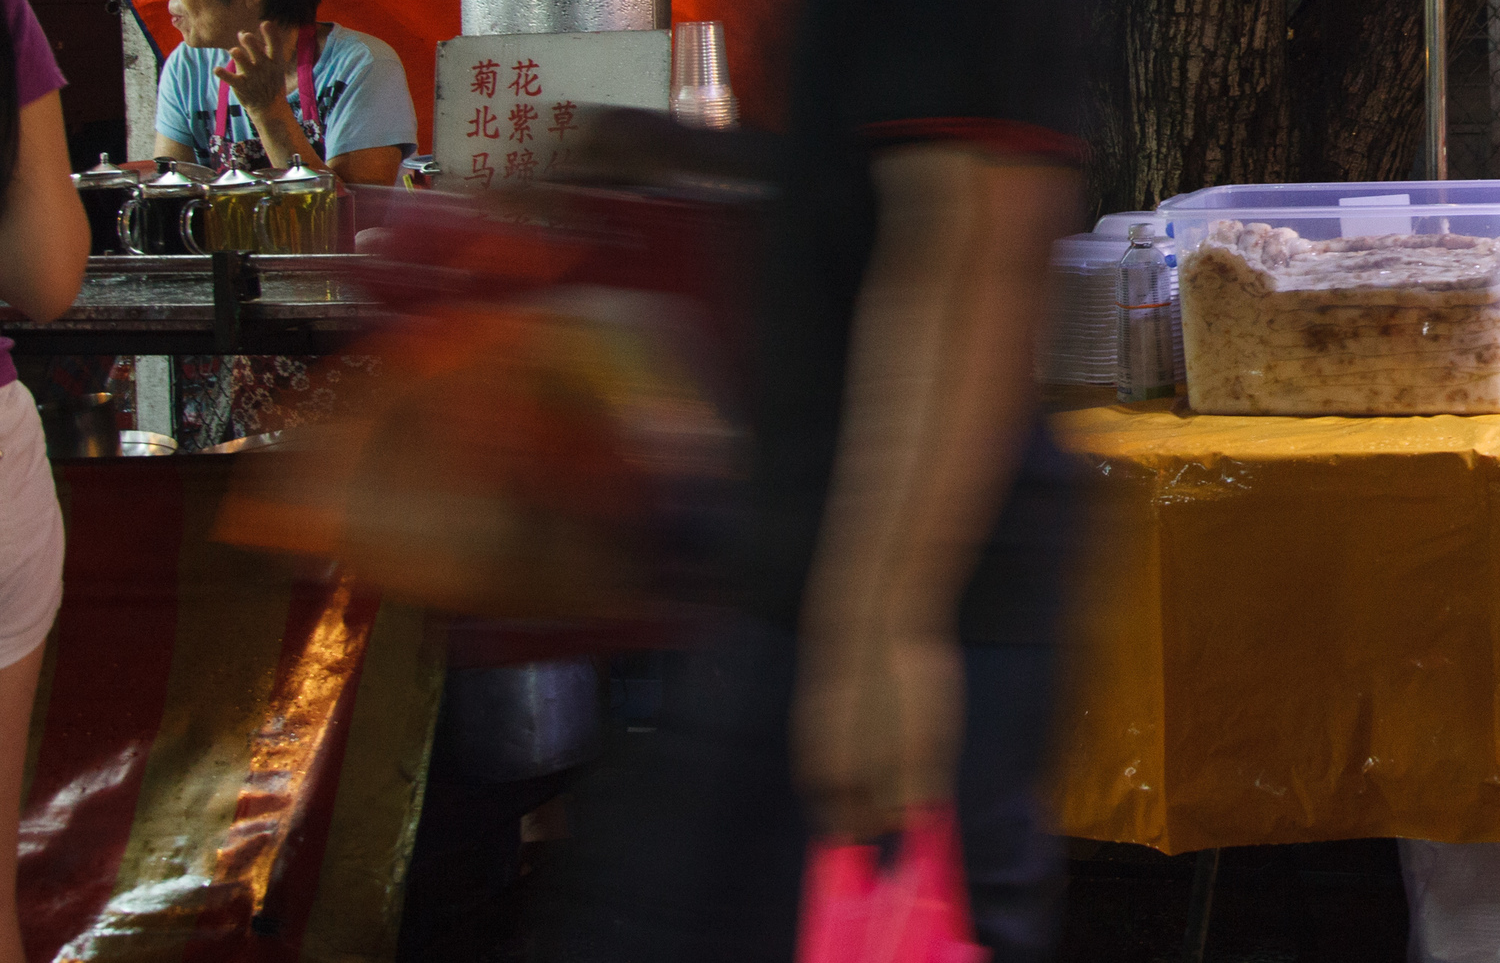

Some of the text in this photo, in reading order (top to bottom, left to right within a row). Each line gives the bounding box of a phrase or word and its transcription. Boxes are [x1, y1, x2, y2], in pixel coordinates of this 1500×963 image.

[470, 58, 543, 99] 菊花
[466, 100, 579, 144] 北紫草
